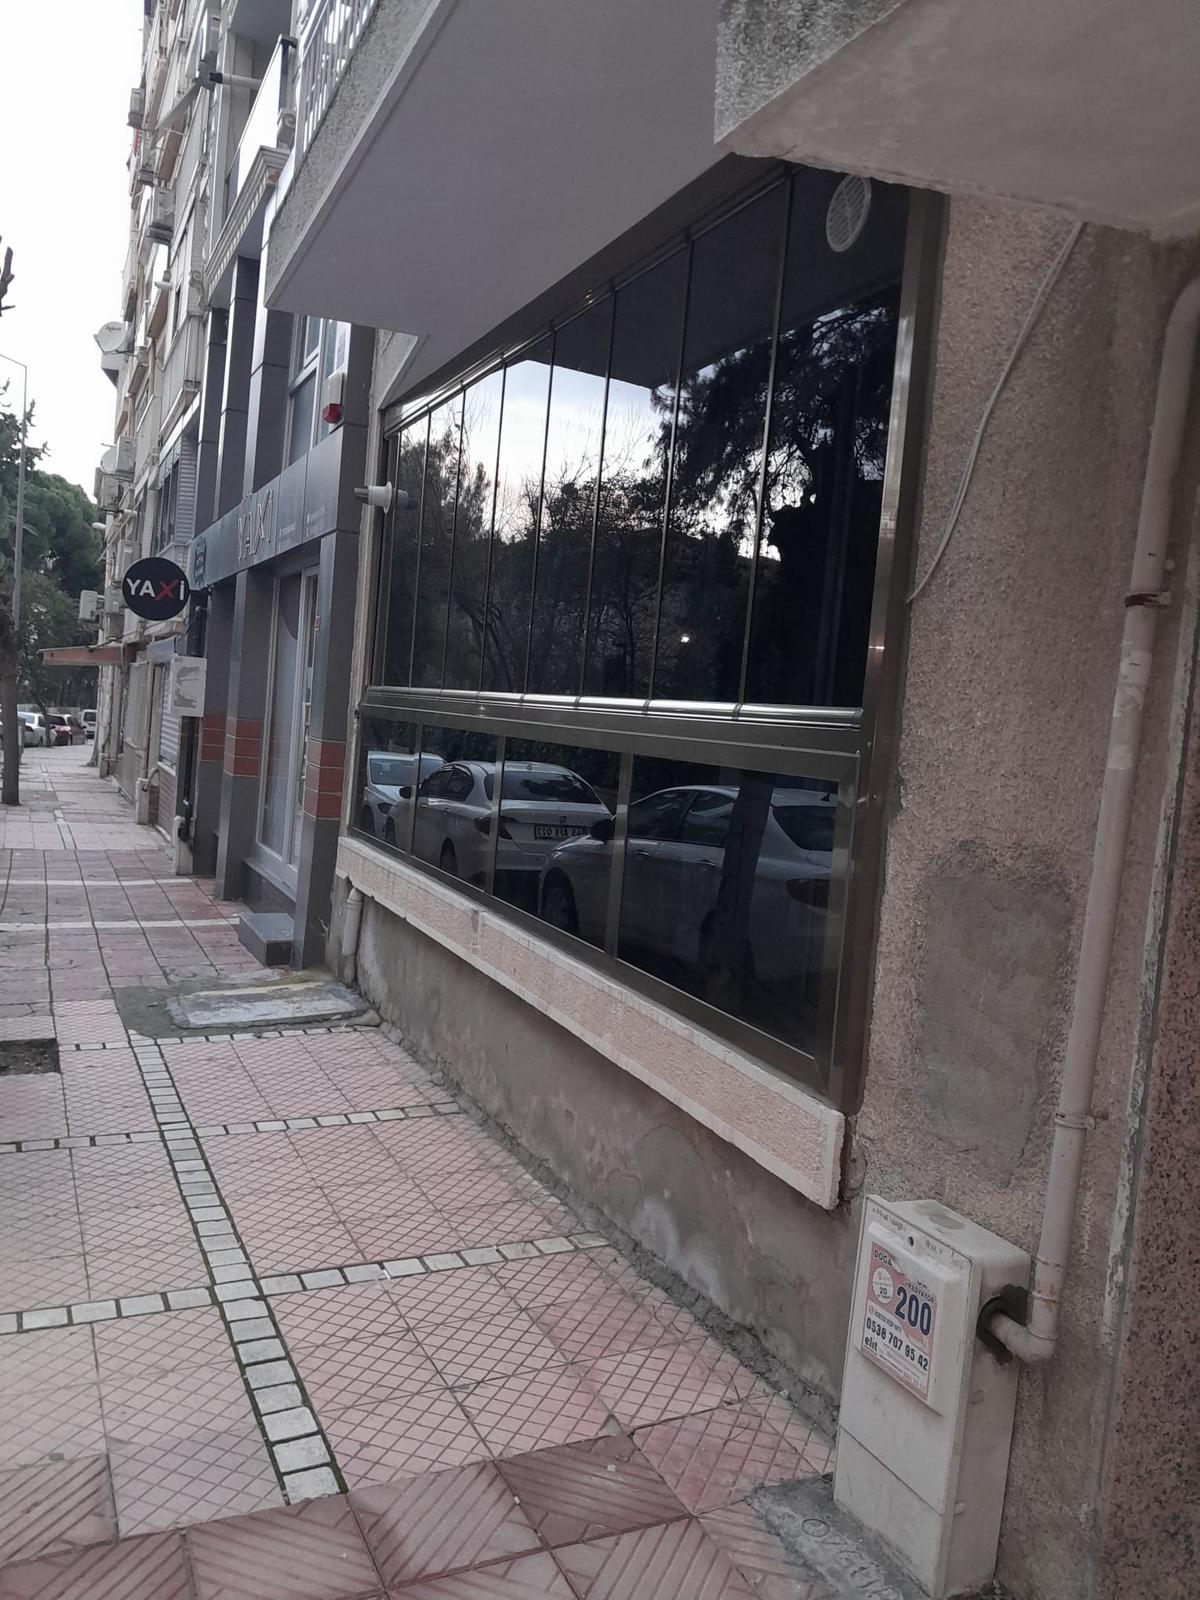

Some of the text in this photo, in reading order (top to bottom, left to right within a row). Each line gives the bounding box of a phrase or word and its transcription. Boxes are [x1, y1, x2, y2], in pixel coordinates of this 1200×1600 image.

[895, 1286, 931, 1336] 200
[866, 1317, 886, 1340] 0538
[888, 1332, 903, 1351] 707
[904, 1344, 915, 1361] 95
[917, 1354, 929, 1371] 42
